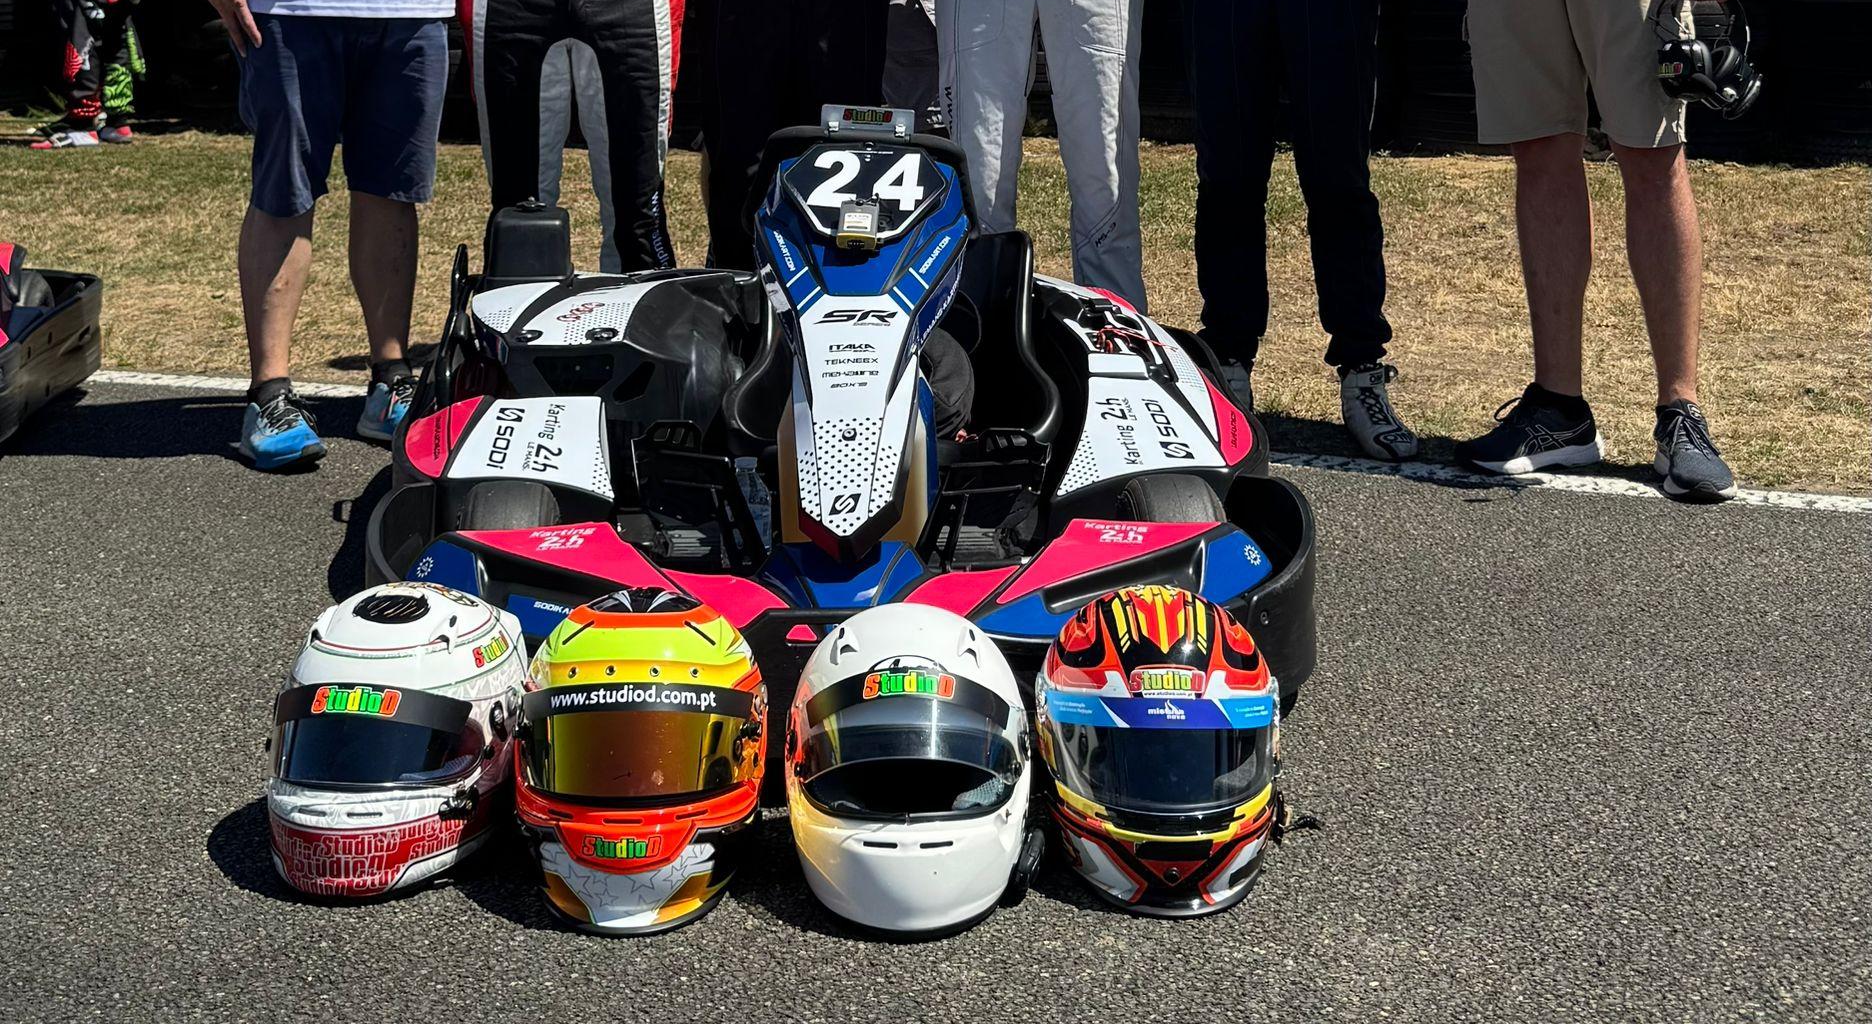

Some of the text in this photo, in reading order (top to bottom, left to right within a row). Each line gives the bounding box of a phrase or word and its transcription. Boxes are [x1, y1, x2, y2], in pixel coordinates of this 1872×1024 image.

[806, 150, 925, 211] 24
[537, 403, 566, 441] Karting
[1142, 398, 1180, 439] SODI
[486, 424, 515, 470] SODI
[1116, 424, 1141, 465] Karting
[533, 600, 576, 615] SODIKA
[862, 669, 956, 700] StudioD
[1129, 670, 1206, 693] StudioD
[311, 686, 402, 717] StudioD
[550, 684, 717, 711] www.studiod.com.pt
[581, 835, 662, 859] StudioD
